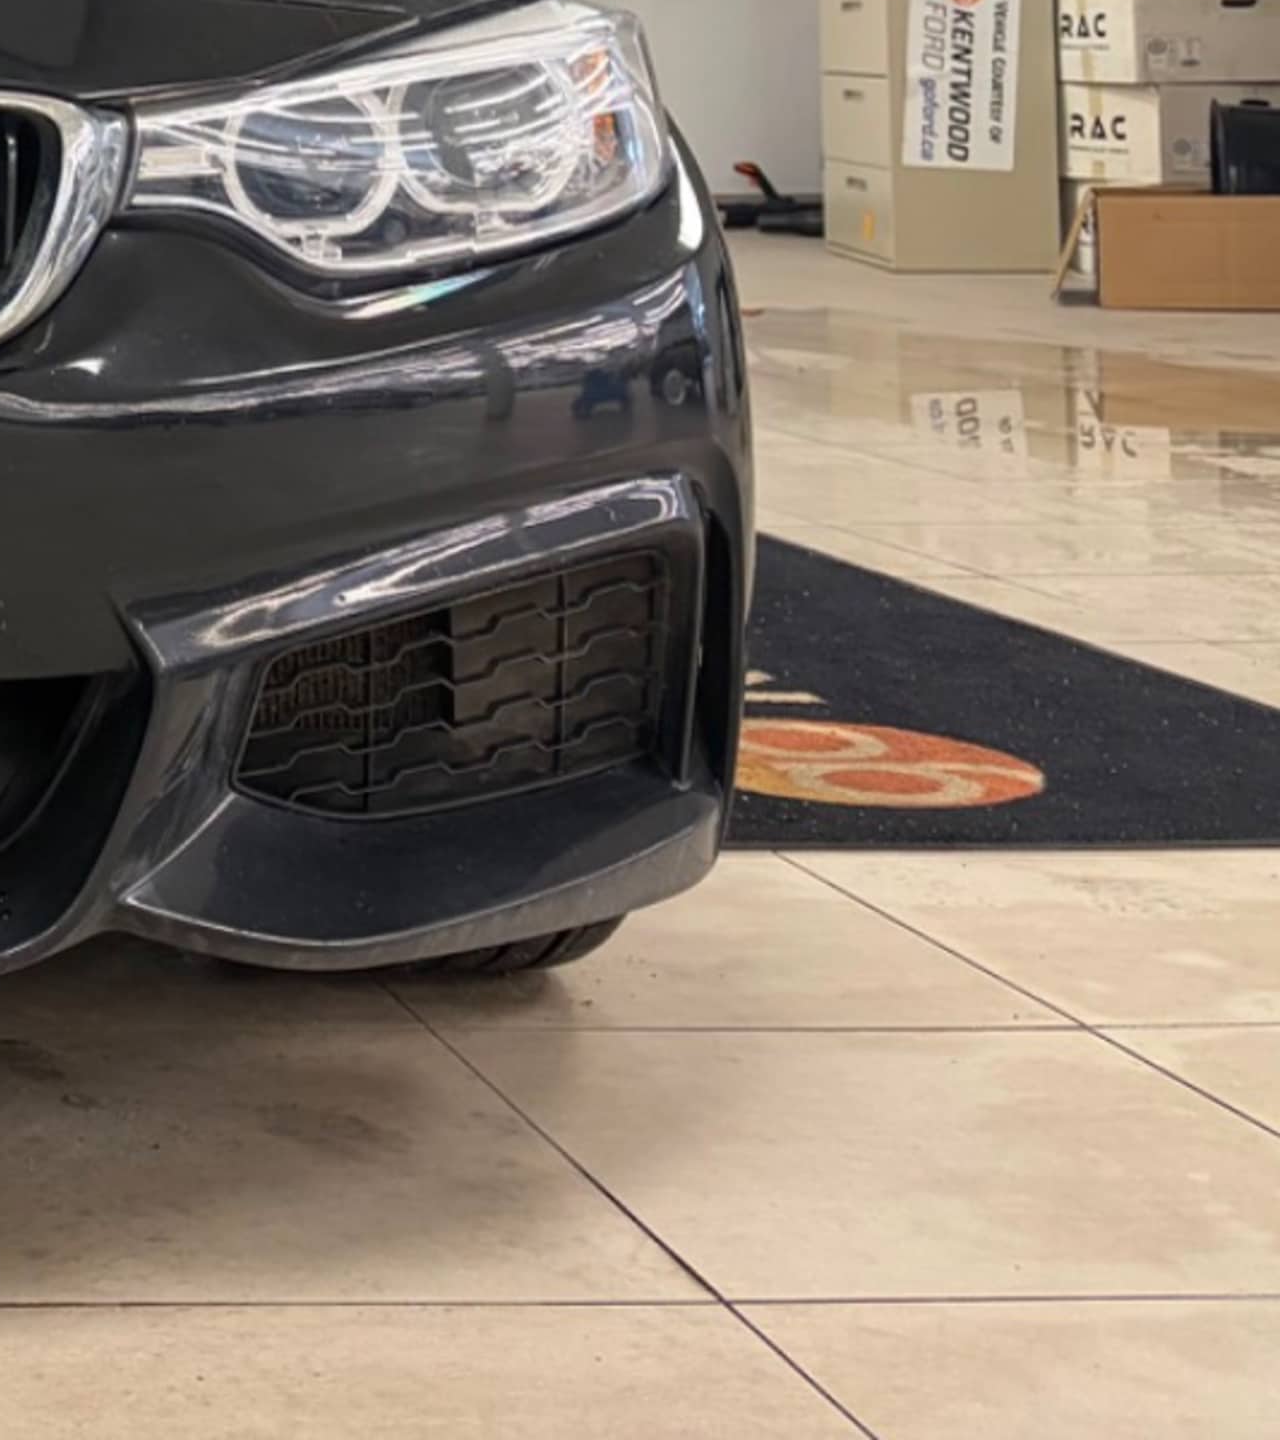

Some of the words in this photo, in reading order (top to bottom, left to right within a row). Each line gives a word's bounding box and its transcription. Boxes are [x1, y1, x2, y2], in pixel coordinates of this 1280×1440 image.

[921, 0, 947, 71] FORD
[919, 78, 940, 162] goford.ca
[947, 8, 975, 162] KENTWOOD
[1069, 112, 1127, 141] RAC
